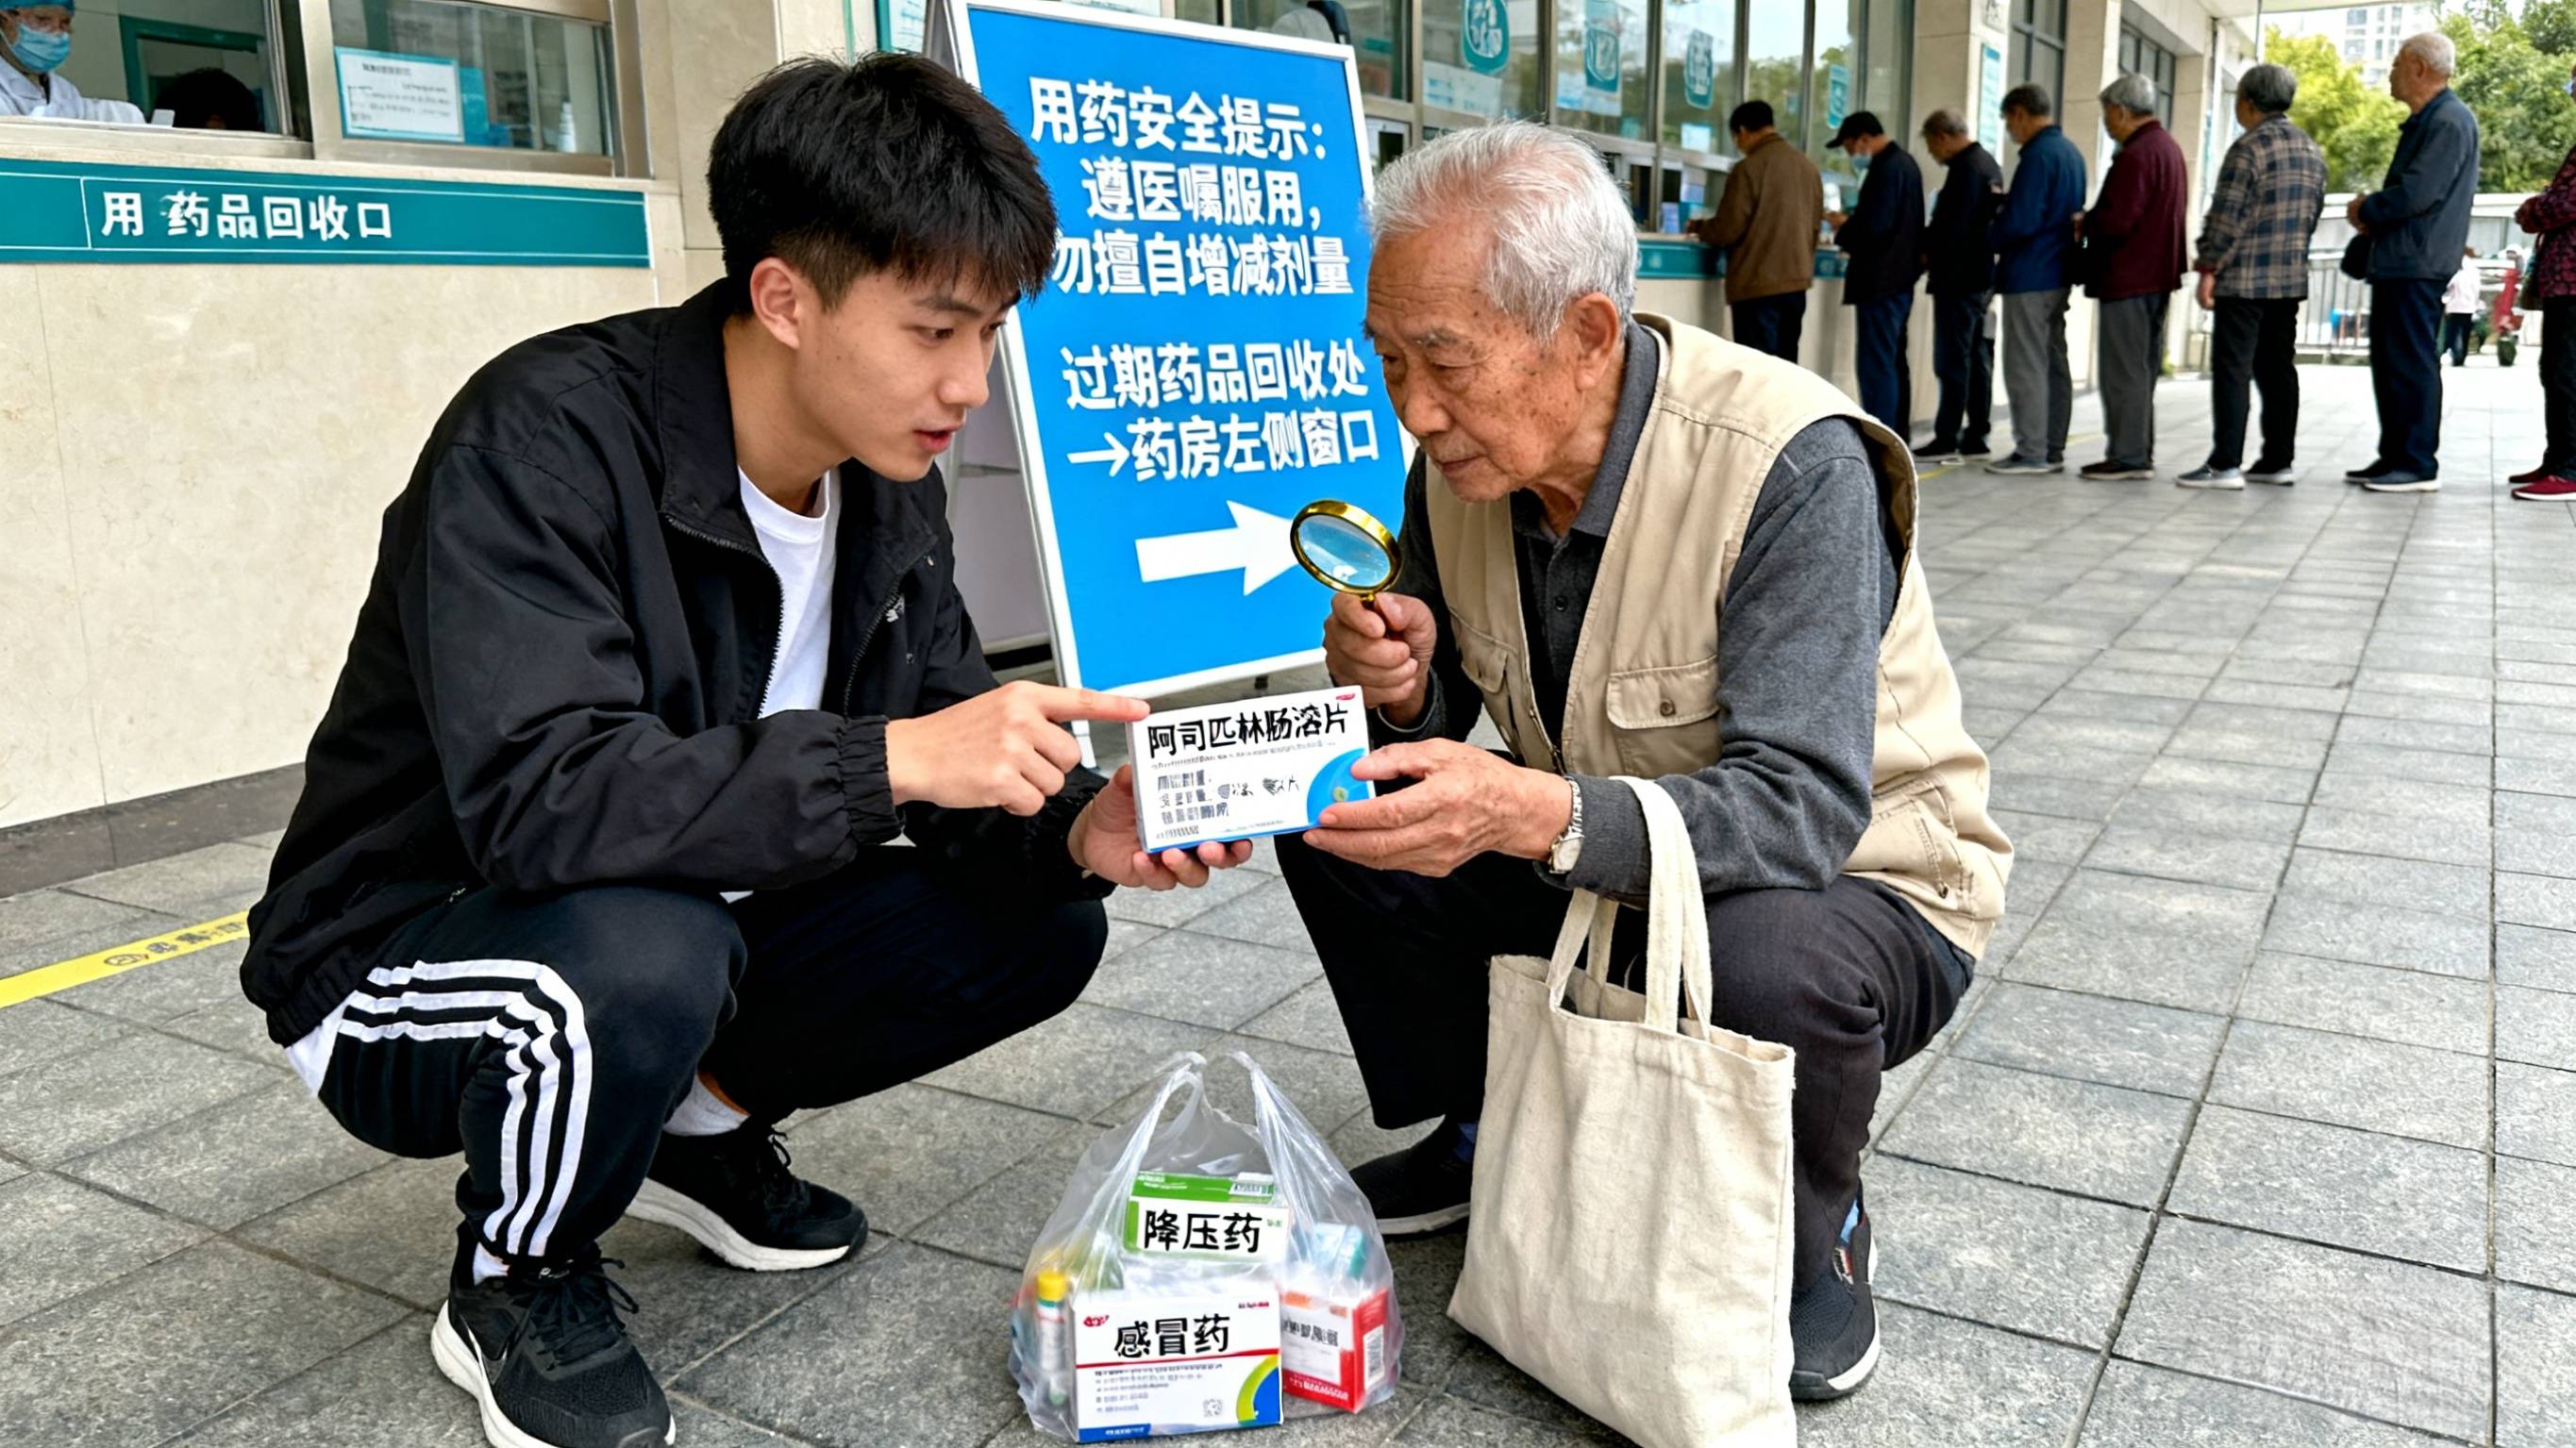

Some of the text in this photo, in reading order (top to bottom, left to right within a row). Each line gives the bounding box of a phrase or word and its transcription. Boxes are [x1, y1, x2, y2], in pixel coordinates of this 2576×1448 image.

[1029, 76, 1326, 160] 用药安全提示：
[1051, 228, 1354, 297] 勿擅自增减剂量
[1060, 338, 1368, 409] 过期药品回收处
[1126, 407, 1380, 482] 药房左侧窗口
[1147, 702, 1348, 758] 阿司匹林肠溶片
[1144, 1208, 1263, 1254] 降压药
[1114, 1313, 1230, 1358] 感冒药
